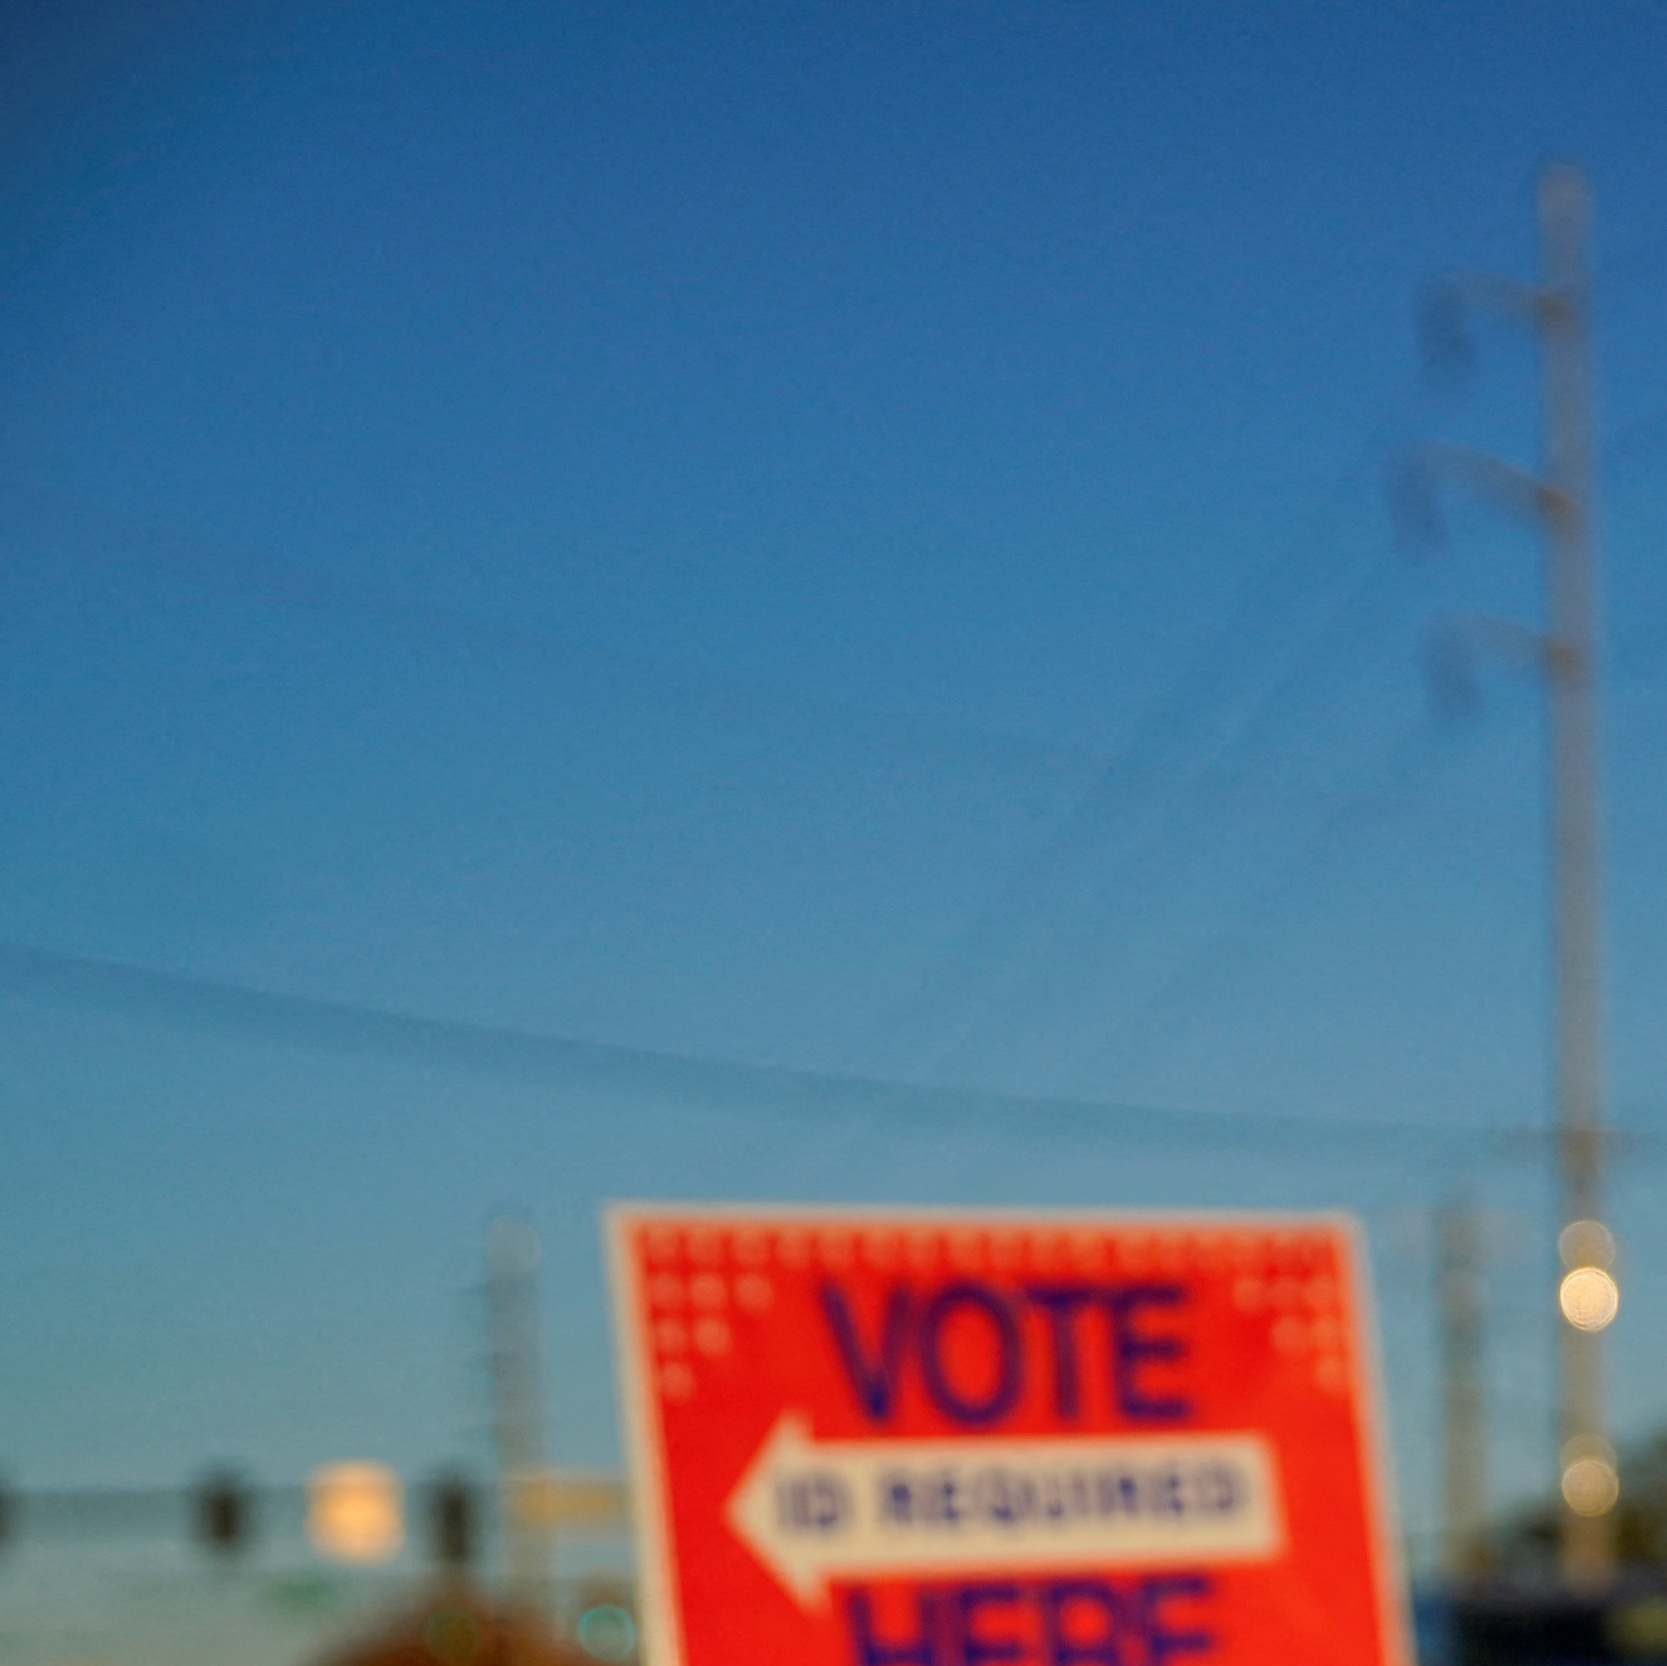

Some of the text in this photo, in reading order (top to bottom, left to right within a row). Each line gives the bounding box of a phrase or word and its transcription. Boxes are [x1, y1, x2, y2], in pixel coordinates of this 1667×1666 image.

[817, 1279, 1195, 1425] VOTE
[771, 1465, 1247, 1531] ID REQUIRED
